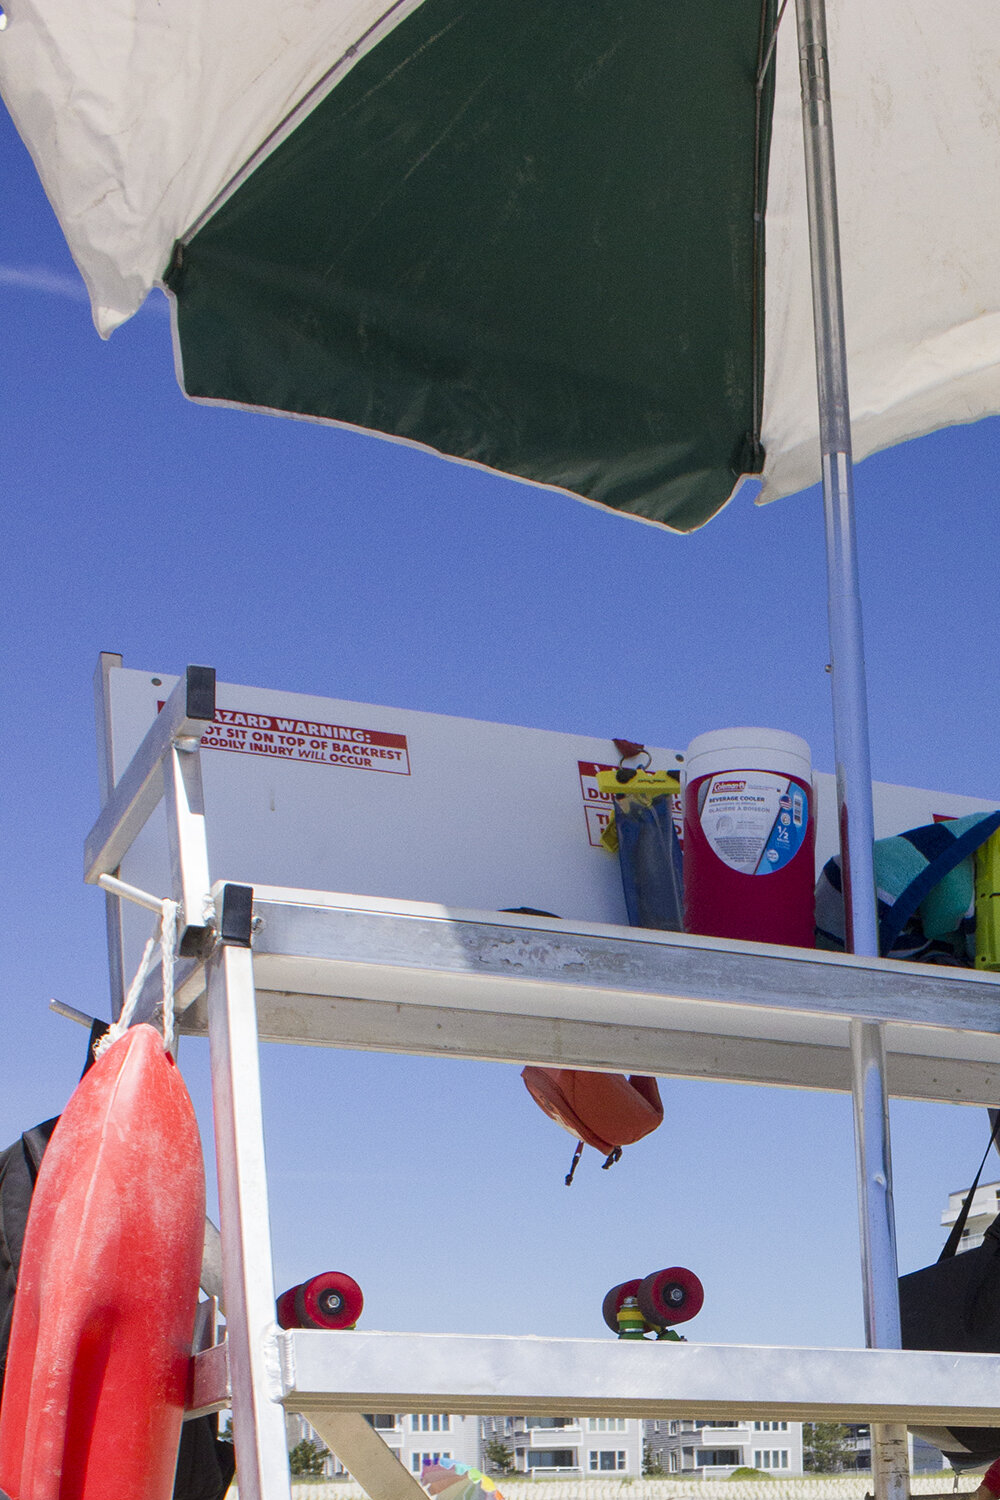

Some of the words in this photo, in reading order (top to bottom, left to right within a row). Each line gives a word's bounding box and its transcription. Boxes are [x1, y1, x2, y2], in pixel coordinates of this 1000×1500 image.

[215, 711, 271, 729] AZARD
[276, 719, 371, 744] WARNING:
[201, 736, 246, 750] BODILY
[250, 742, 293, 756] INJURY
[298, 750, 326, 761] WILL
[330, 754, 372, 767] OCCUR
[227, 728, 247, 739] SIT
[252, 732, 274, 743] ON
[278, 735, 305, 746] TOP
[310, 740, 328, 750] OF
[333, 743, 402, 761] BACKREST
